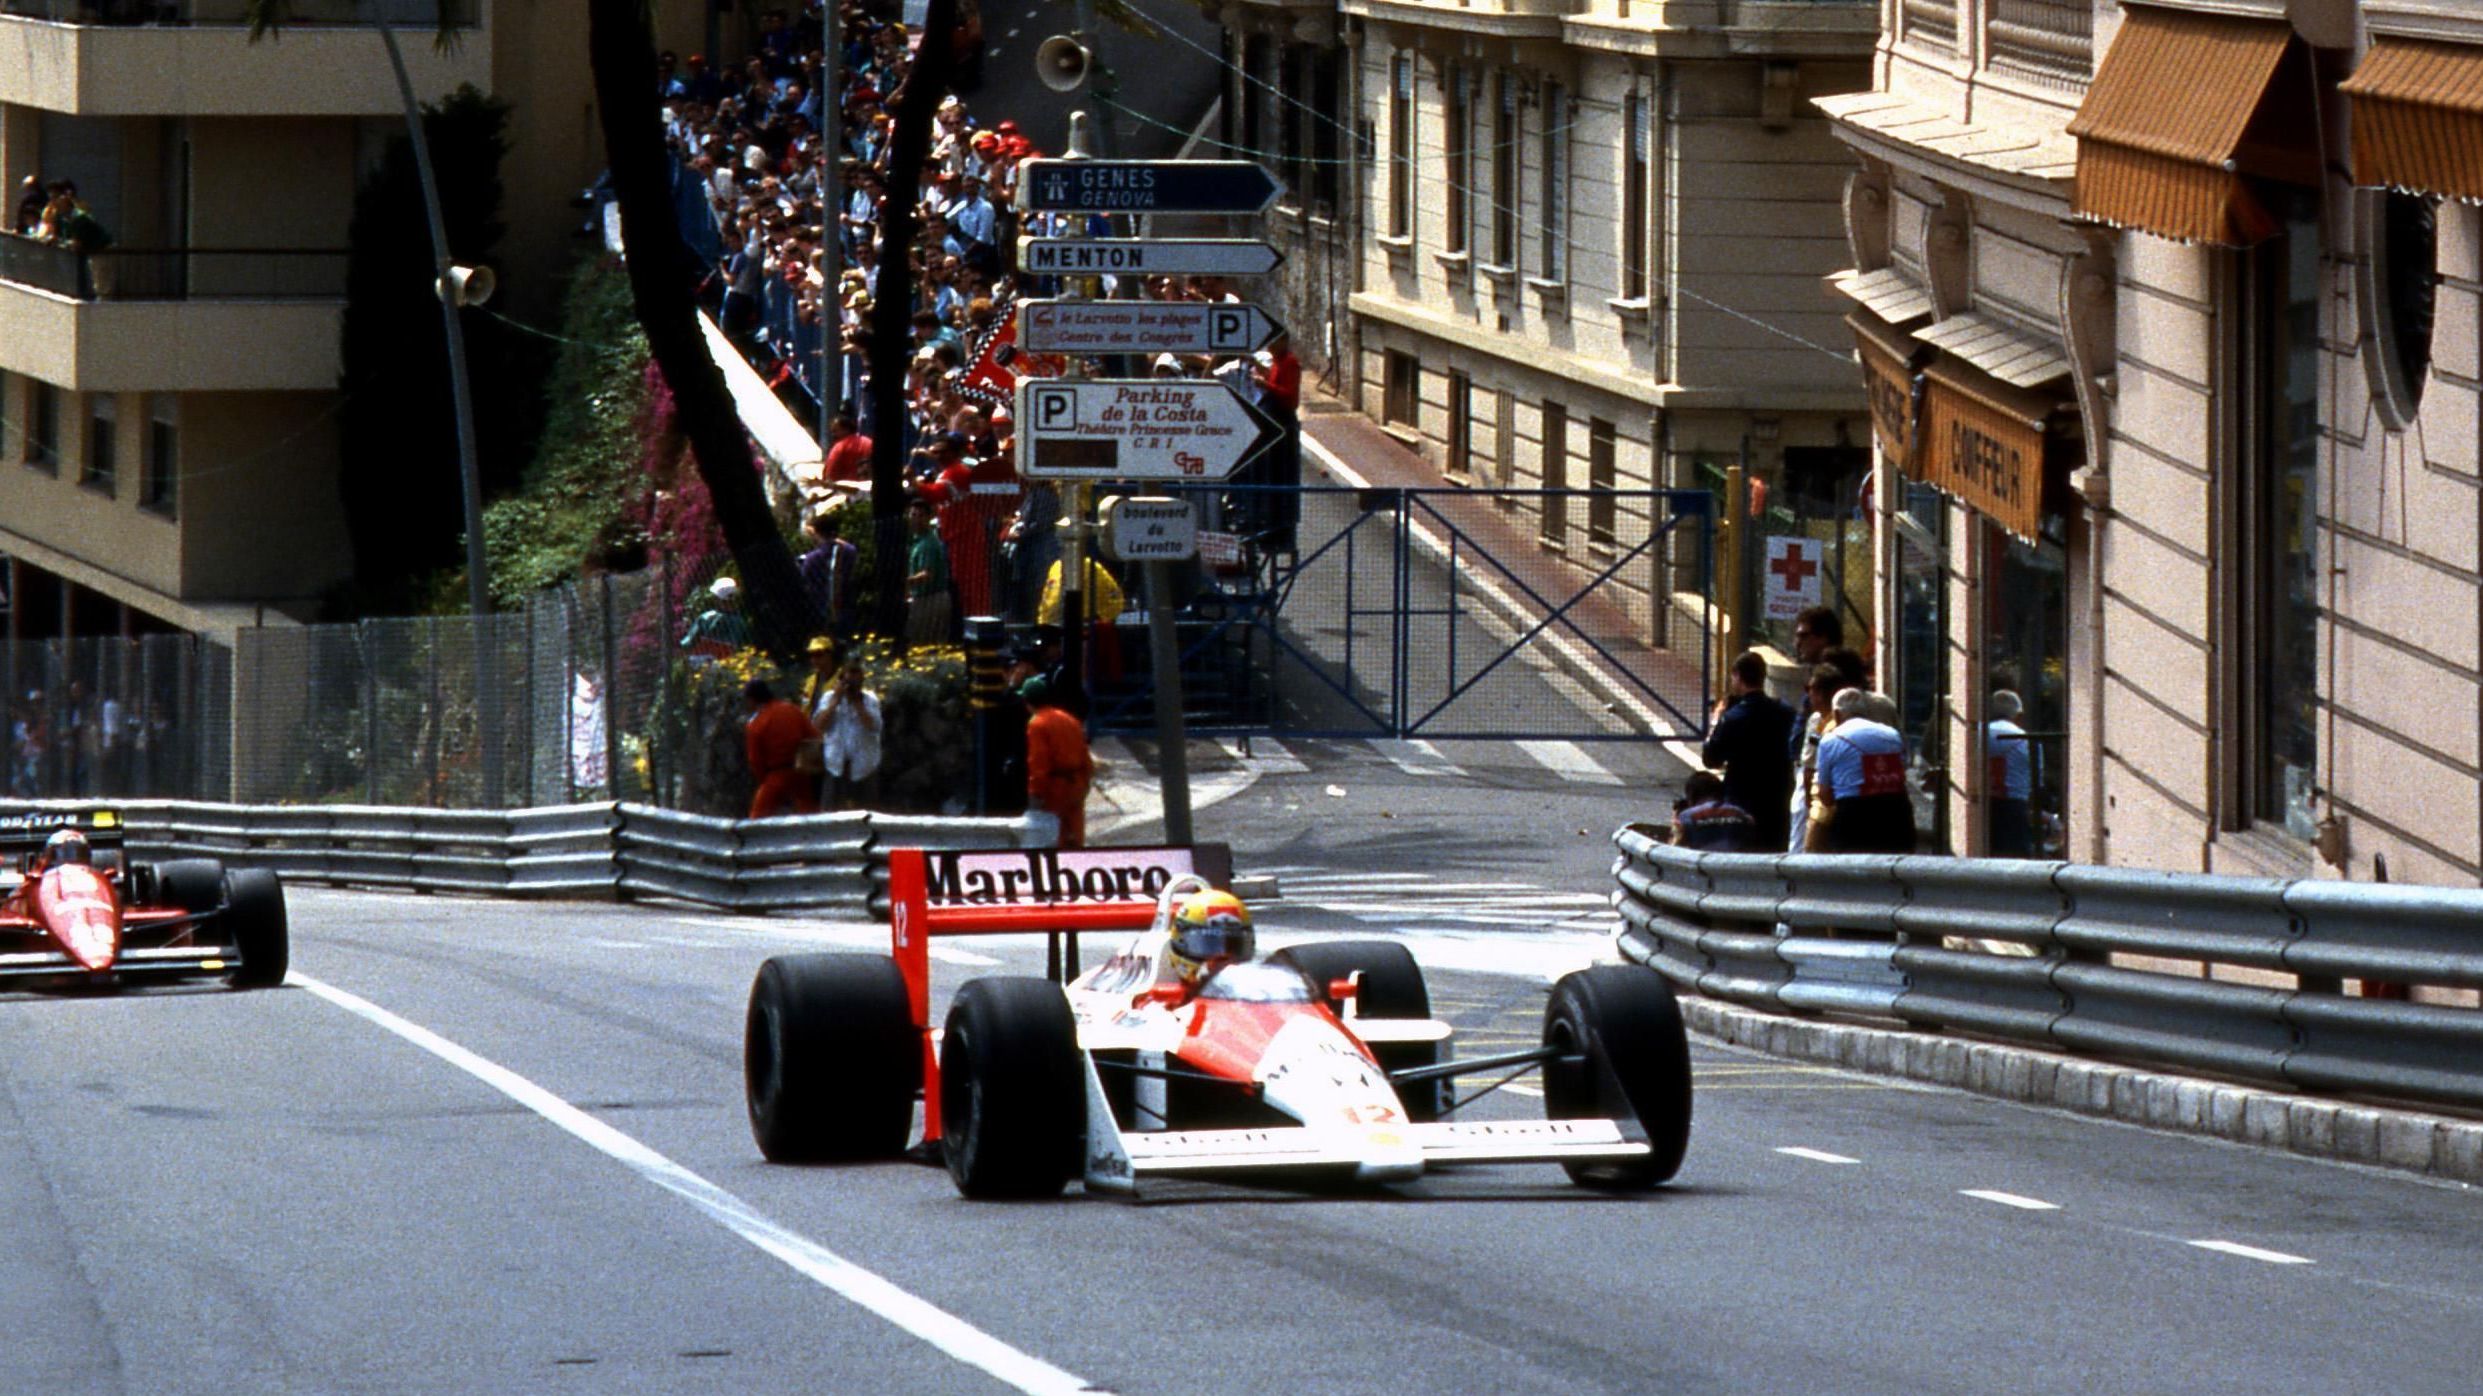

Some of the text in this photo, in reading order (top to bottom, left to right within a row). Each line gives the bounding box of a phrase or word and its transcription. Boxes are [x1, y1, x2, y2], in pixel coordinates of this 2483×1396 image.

[1081, 169, 1155, 187] GENES
[1081, 191, 1155, 206] GENOVA
[1037, 248, 1143, 266] MENTON
[1058, 331, 1103, 344] Centre
[1110, 331, 1132, 344] des
[1218, 314, 1240, 343] P
[1116, 388, 1196, 407] Parking
[1044, 395, 1067, 424] P
[1102, 406, 1209, 422] de la Costa
[1129, 424, 1192, 436] Princesse
[1195, 424, 1233, 436] Grace
[1952, 419, 2021, 510] COIFFEUR
[1124, 506, 1189, 519] boulevard
[1129, 540, 1183, 553] Larvotto
[0, 814, 78, 829] ODYEAR
[926, 850, 1172, 907] Marlboro
[1342, 1104, 1396, 1125] 12
